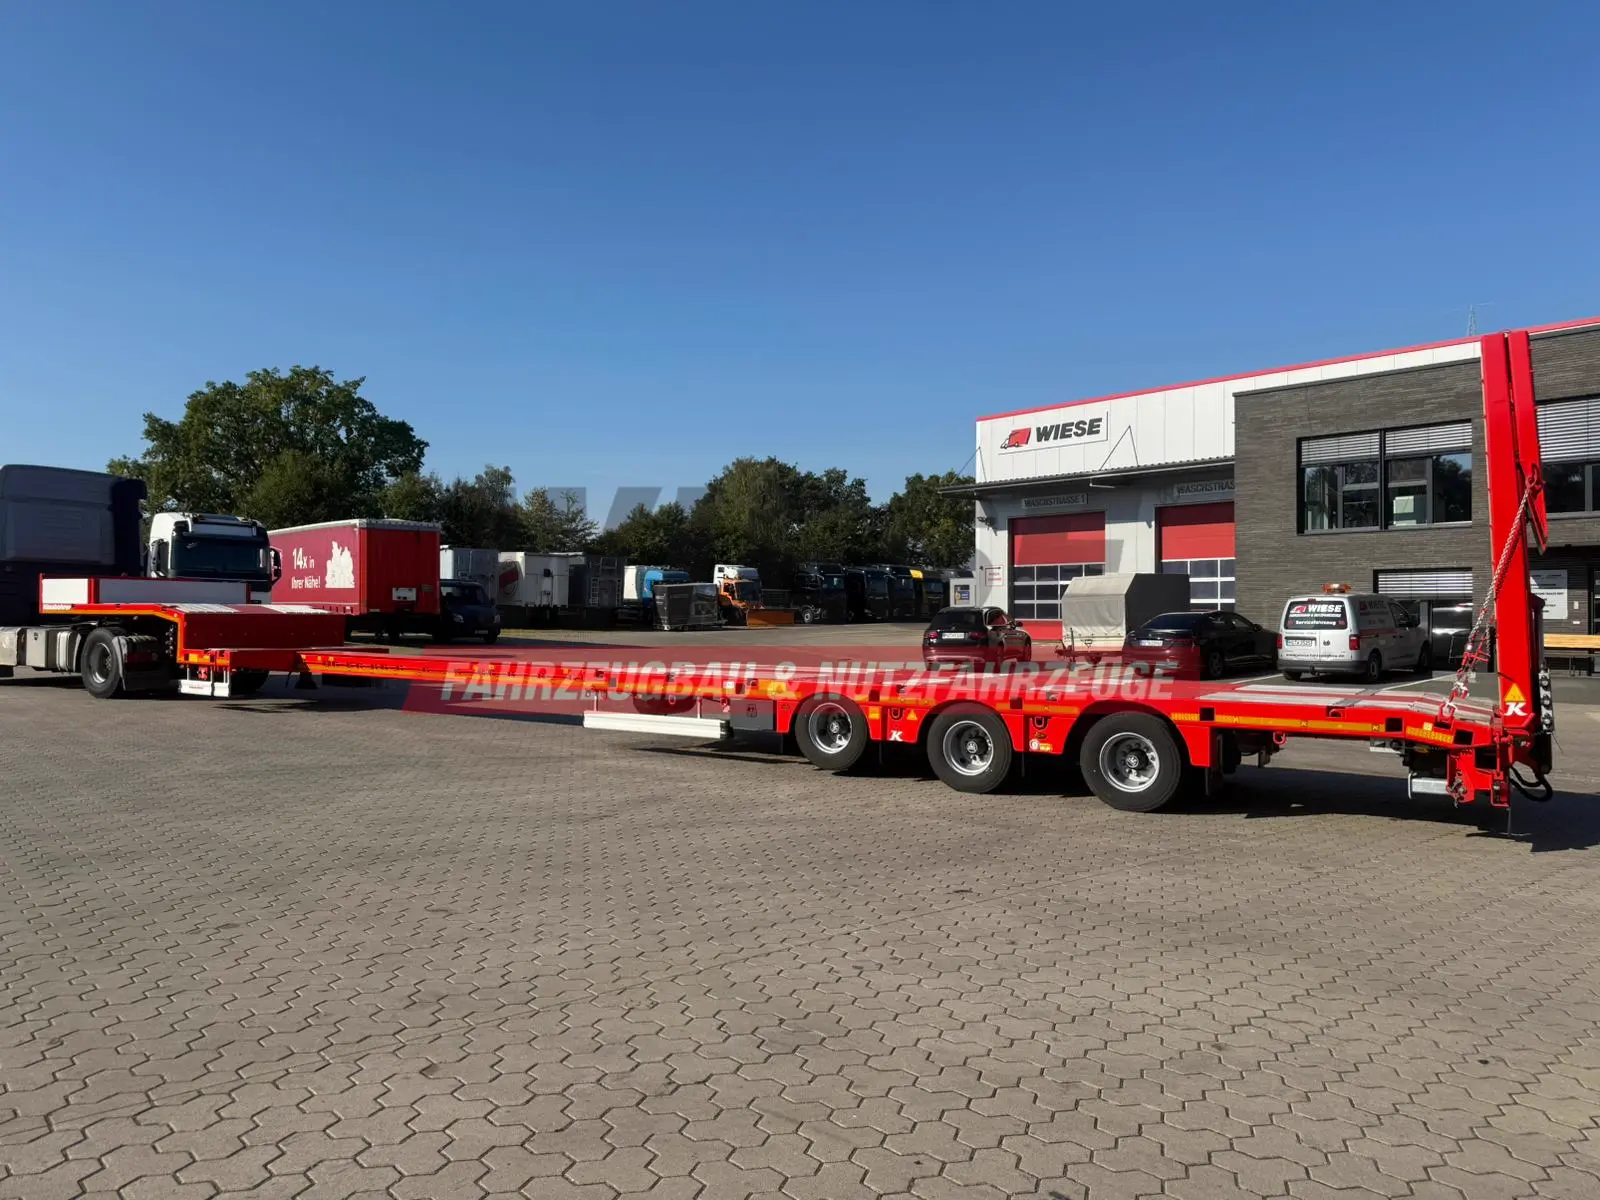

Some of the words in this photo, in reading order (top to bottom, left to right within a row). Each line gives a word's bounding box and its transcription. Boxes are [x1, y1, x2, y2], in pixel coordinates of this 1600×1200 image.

[1036, 417, 1102, 442] WIESE
[293, 547, 308, 569] 14x
[309, 556, 315, 569] in
[291, 576, 304, 589] Ihrer
[1308, 604, 1342, 613] WIESE
